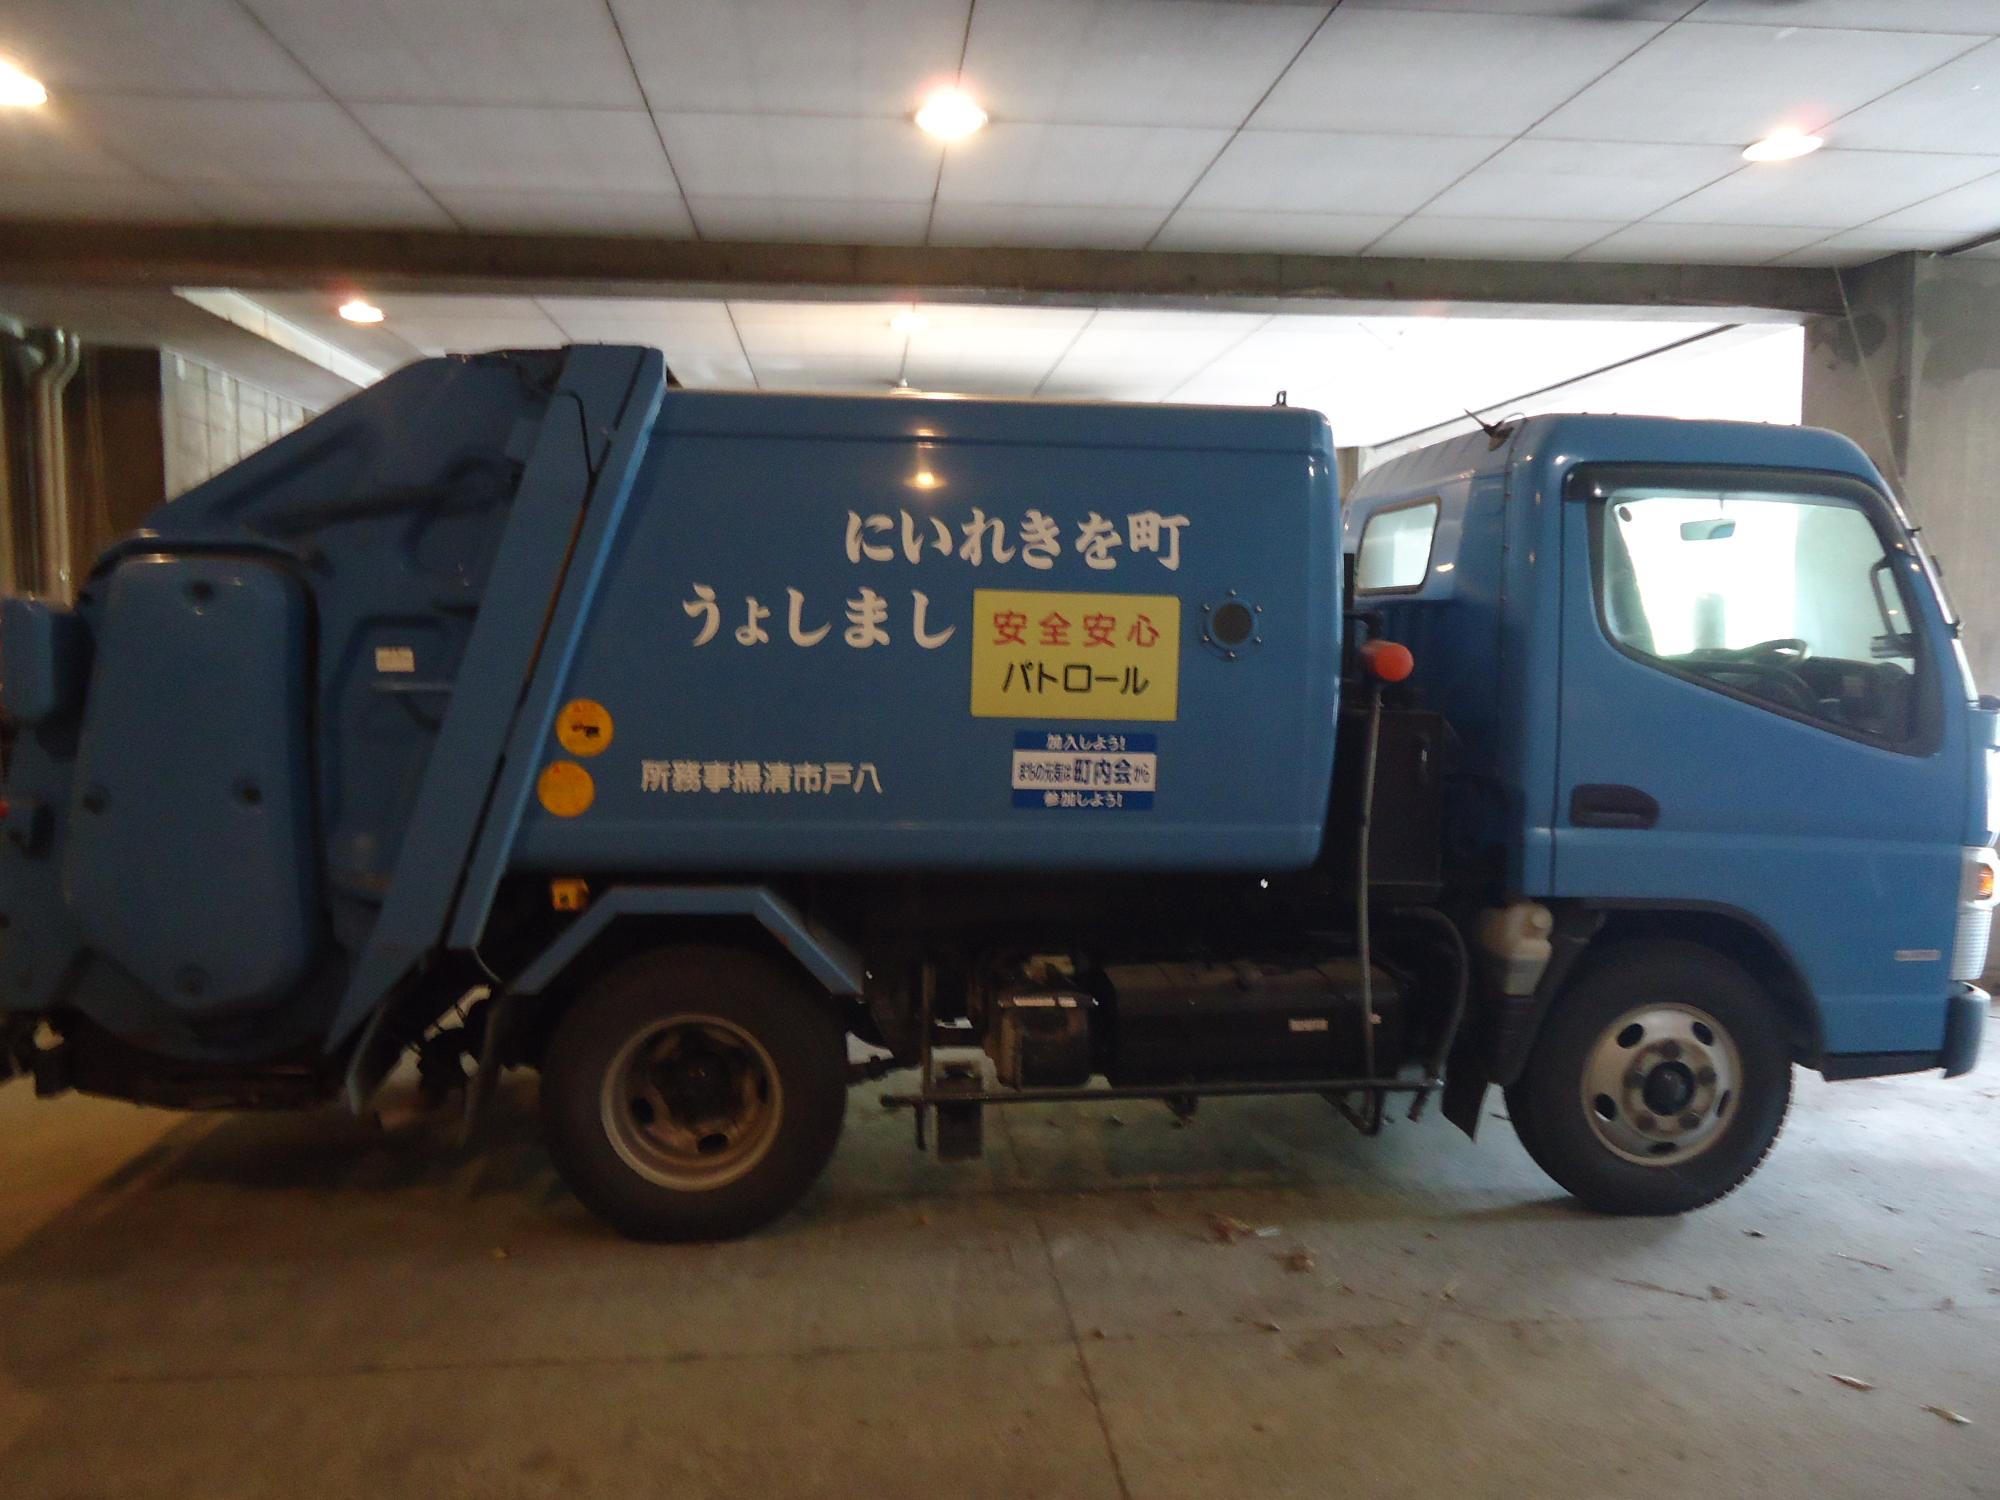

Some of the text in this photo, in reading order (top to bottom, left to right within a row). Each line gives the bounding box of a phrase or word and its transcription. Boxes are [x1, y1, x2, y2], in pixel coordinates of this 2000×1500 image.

[993, 610, 1161, 648] 安全安心
[1001, 662, 1150, 696] パトロール
